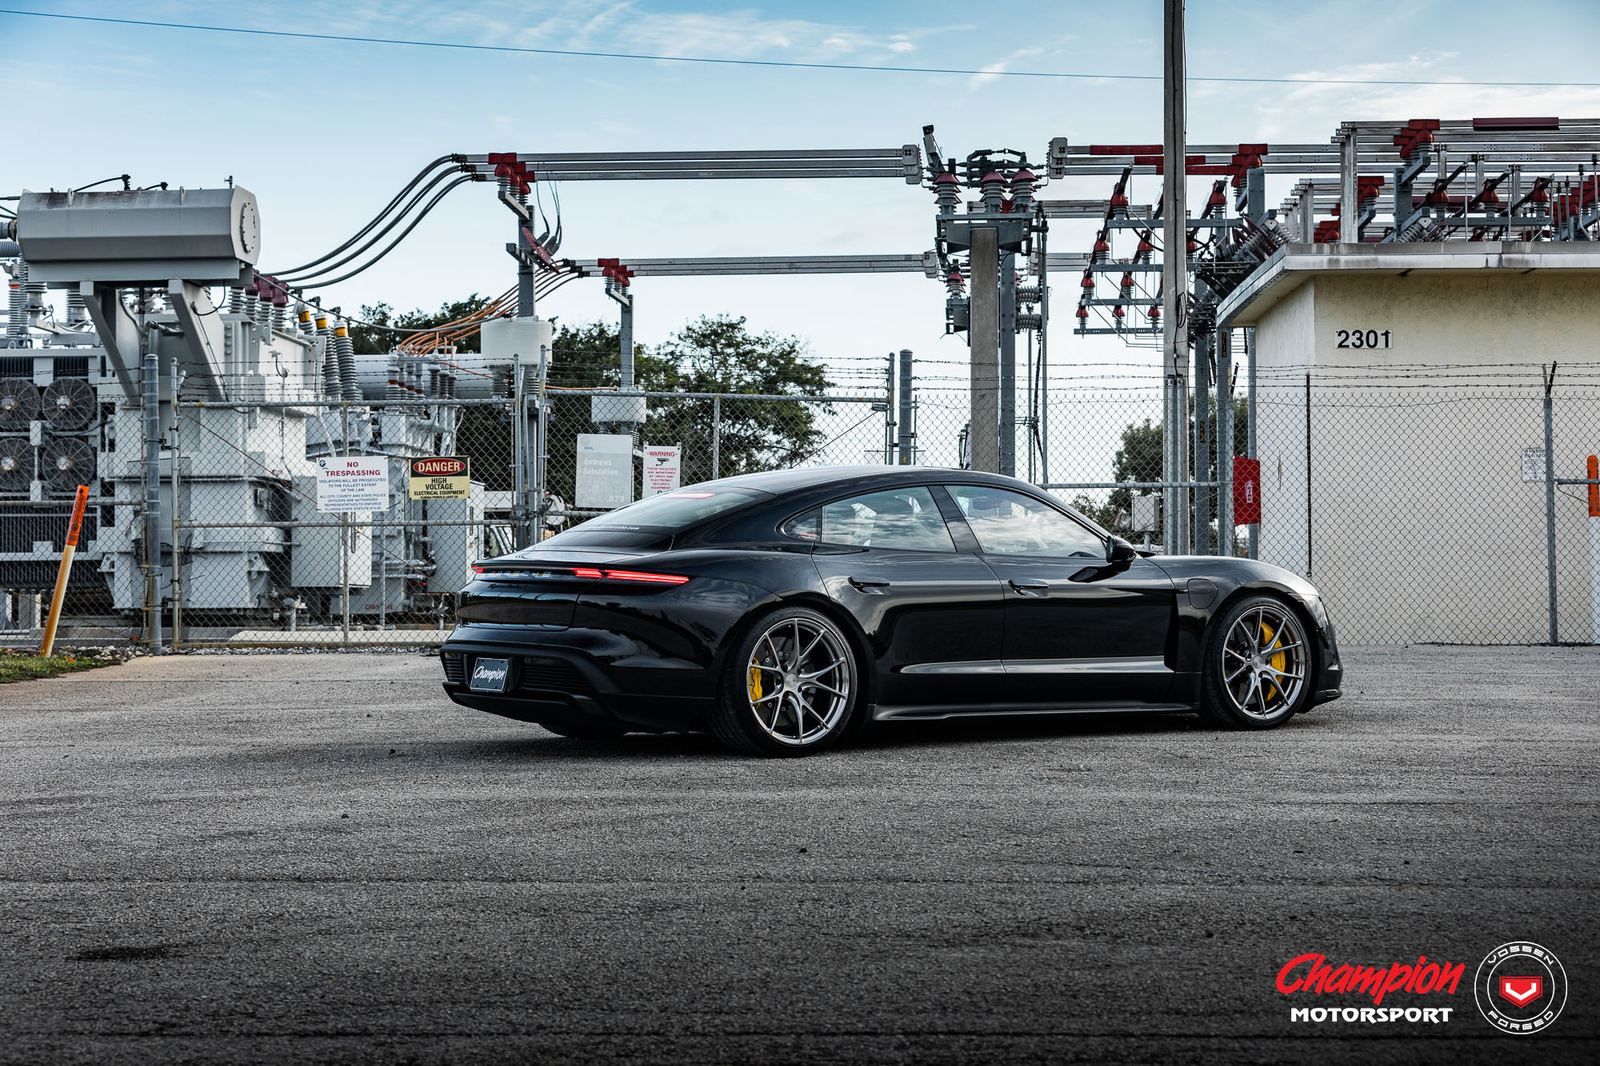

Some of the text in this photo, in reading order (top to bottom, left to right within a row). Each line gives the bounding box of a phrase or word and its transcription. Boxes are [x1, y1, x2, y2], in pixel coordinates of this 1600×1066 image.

[1337, 329, 1391, 349] 2301
[325, 469, 381, 477] TRESPASSING
[418, 461, 460, 472] DANGER
[474, 665, 506, 683] Champion
